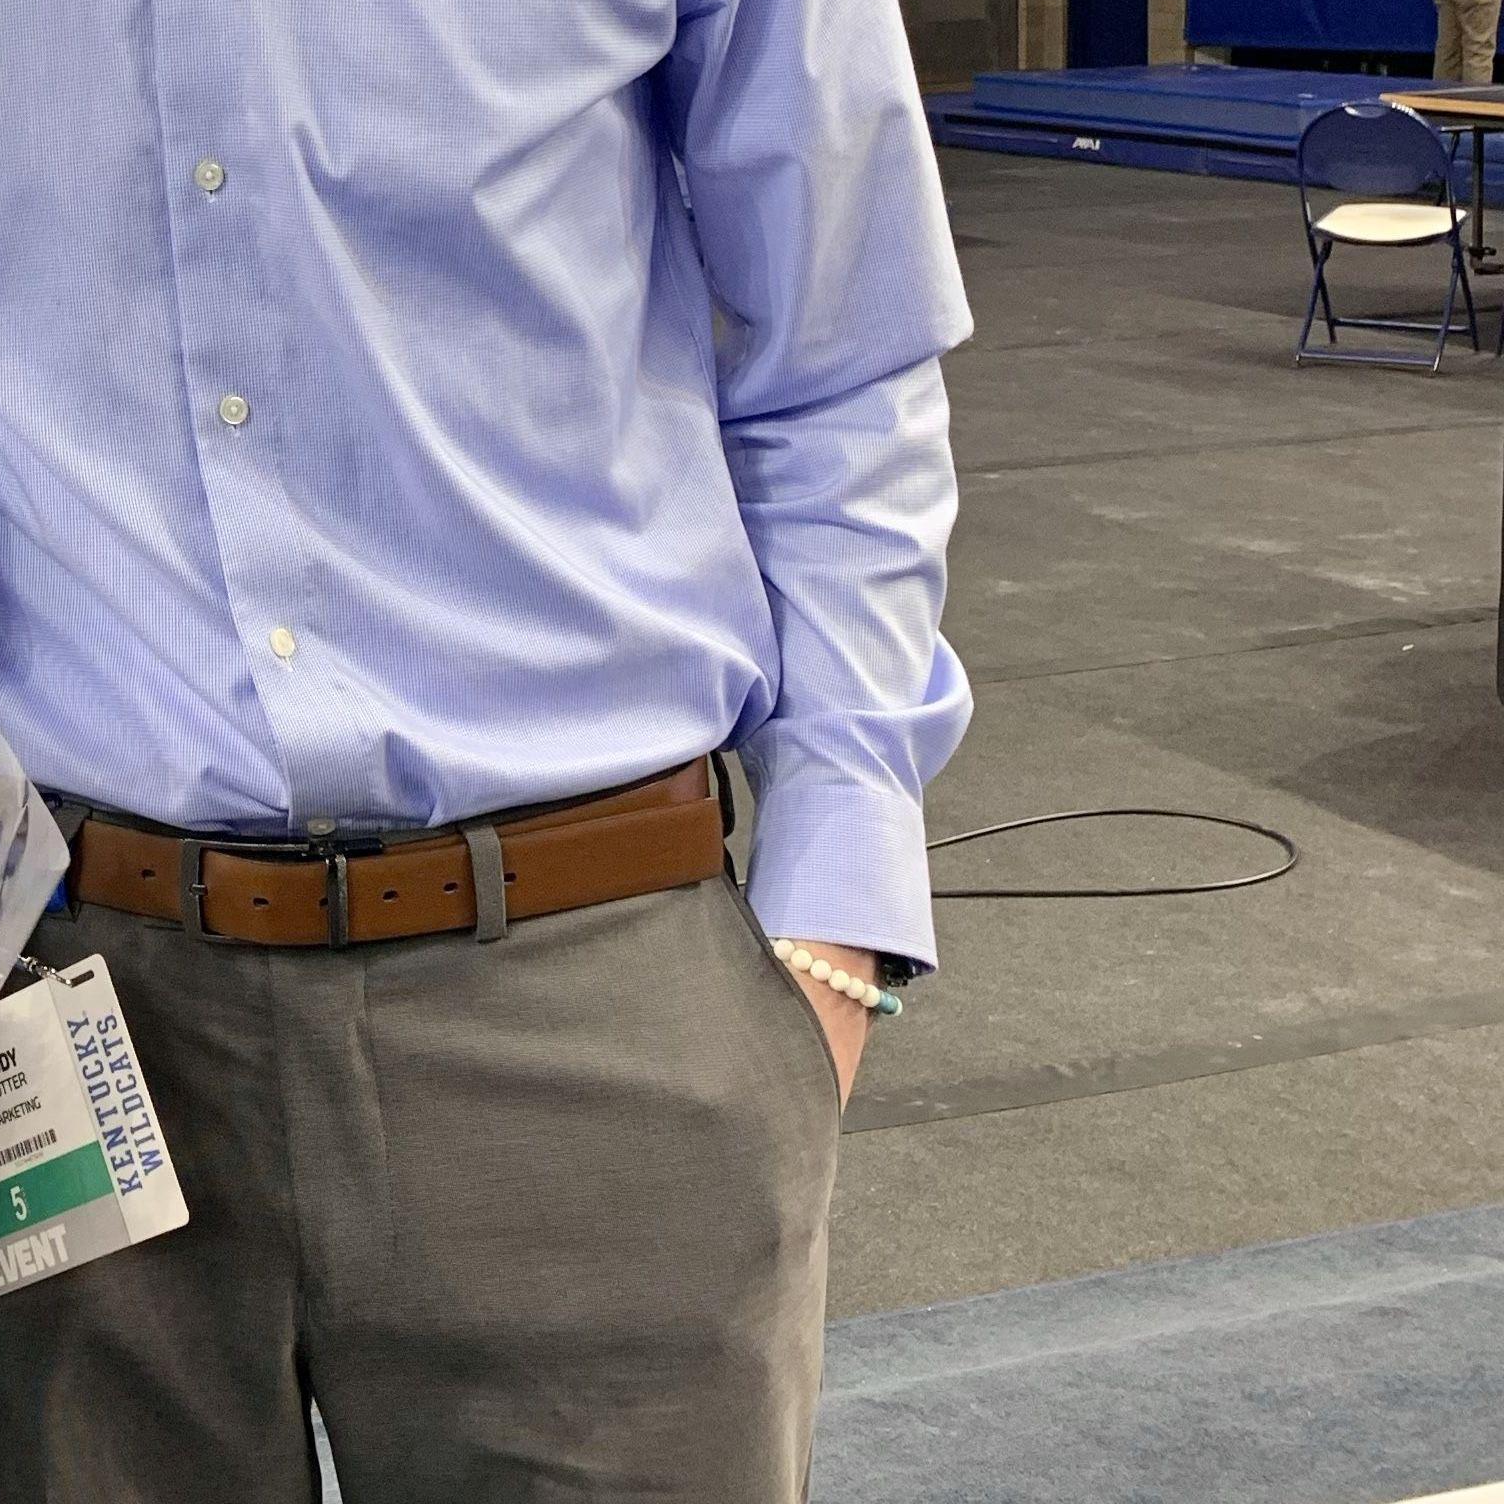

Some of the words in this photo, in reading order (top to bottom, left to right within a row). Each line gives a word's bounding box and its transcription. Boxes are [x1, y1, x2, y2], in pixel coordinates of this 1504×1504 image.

[67, 1015, 142, 1196] KENTUCKY
[96, 1014, 164, 1176] WILDCATS
[10, 1185, 27, 1221] 5
